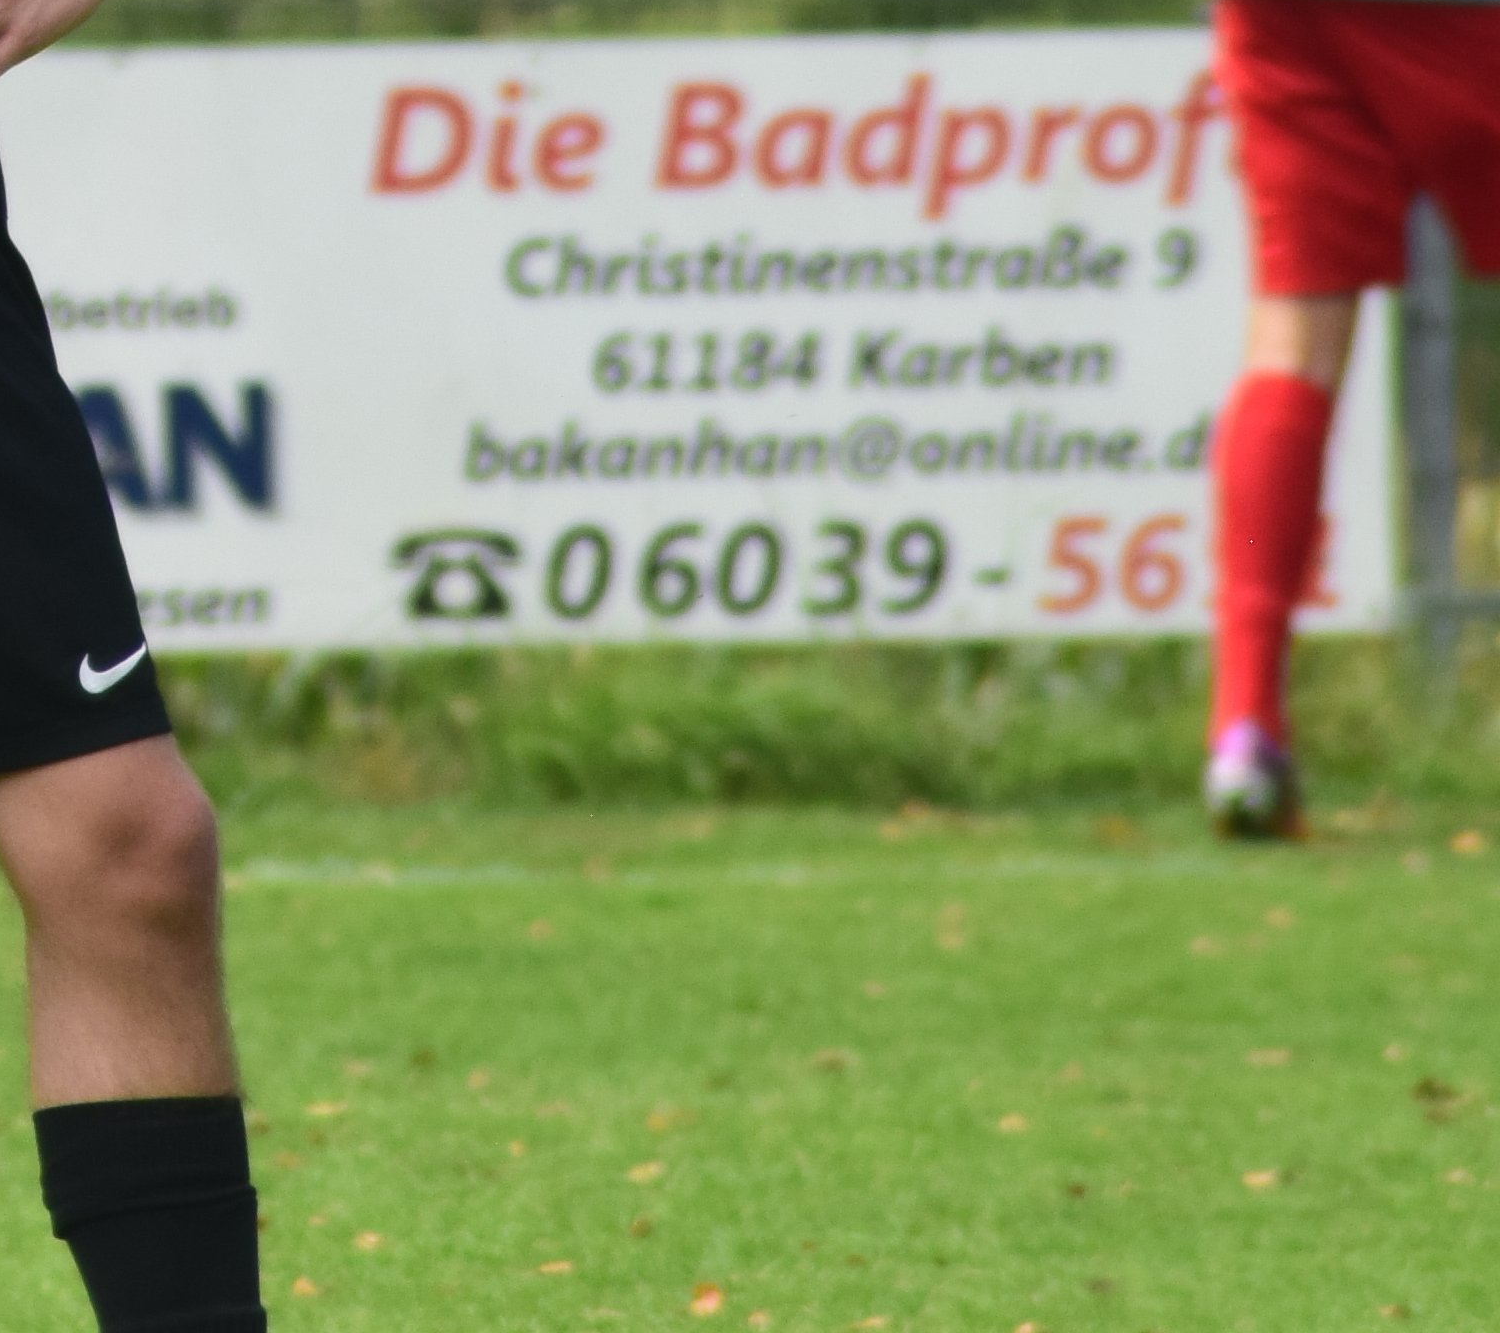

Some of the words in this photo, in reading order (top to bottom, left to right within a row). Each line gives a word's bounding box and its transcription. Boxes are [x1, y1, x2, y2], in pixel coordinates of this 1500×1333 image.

[368, 82, 606, 195] Die
[653, 71, 1238, 219] Badprof
[503, 225, 1128, 298] Christinenstraße
[1154, 229, 1198, 289] 9
[45, 285, 239, 331] betrieb
[590, 334, 818, 393] 61184
[847, 330, 1113, 389] Karben
[462, 411, 1212, 483] bakanhan@online.d
